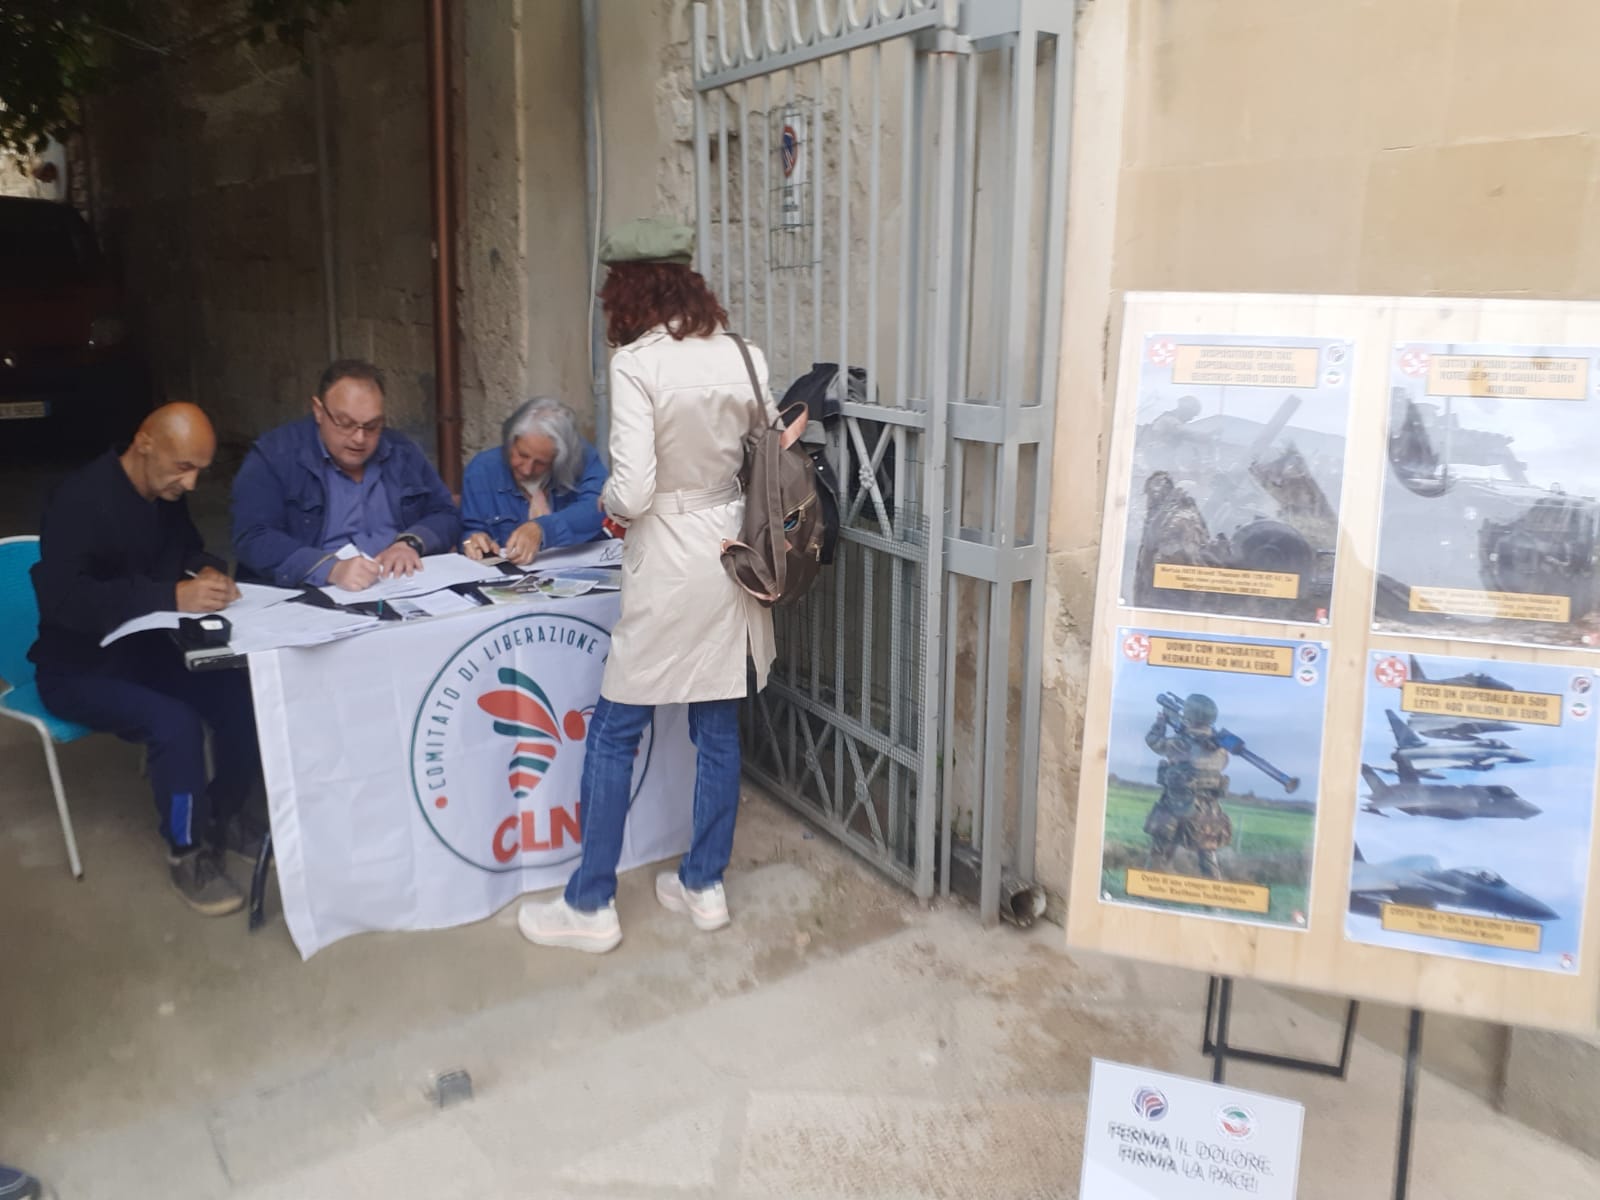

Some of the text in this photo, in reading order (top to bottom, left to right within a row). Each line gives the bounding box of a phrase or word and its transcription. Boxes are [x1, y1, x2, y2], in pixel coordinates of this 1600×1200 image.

[1216, 645, 1275, 659] INCUBATRICE
[1254, 661, 1280, 672] EURO
[425, 625, 599, 791] COMITATO DI LIBERAZIONE
[492, 802, 582, 864] CLN
[1107, 1121, 1171, 1151] FERMA
[1118, 1144, 1178, 1175] FIRMA
